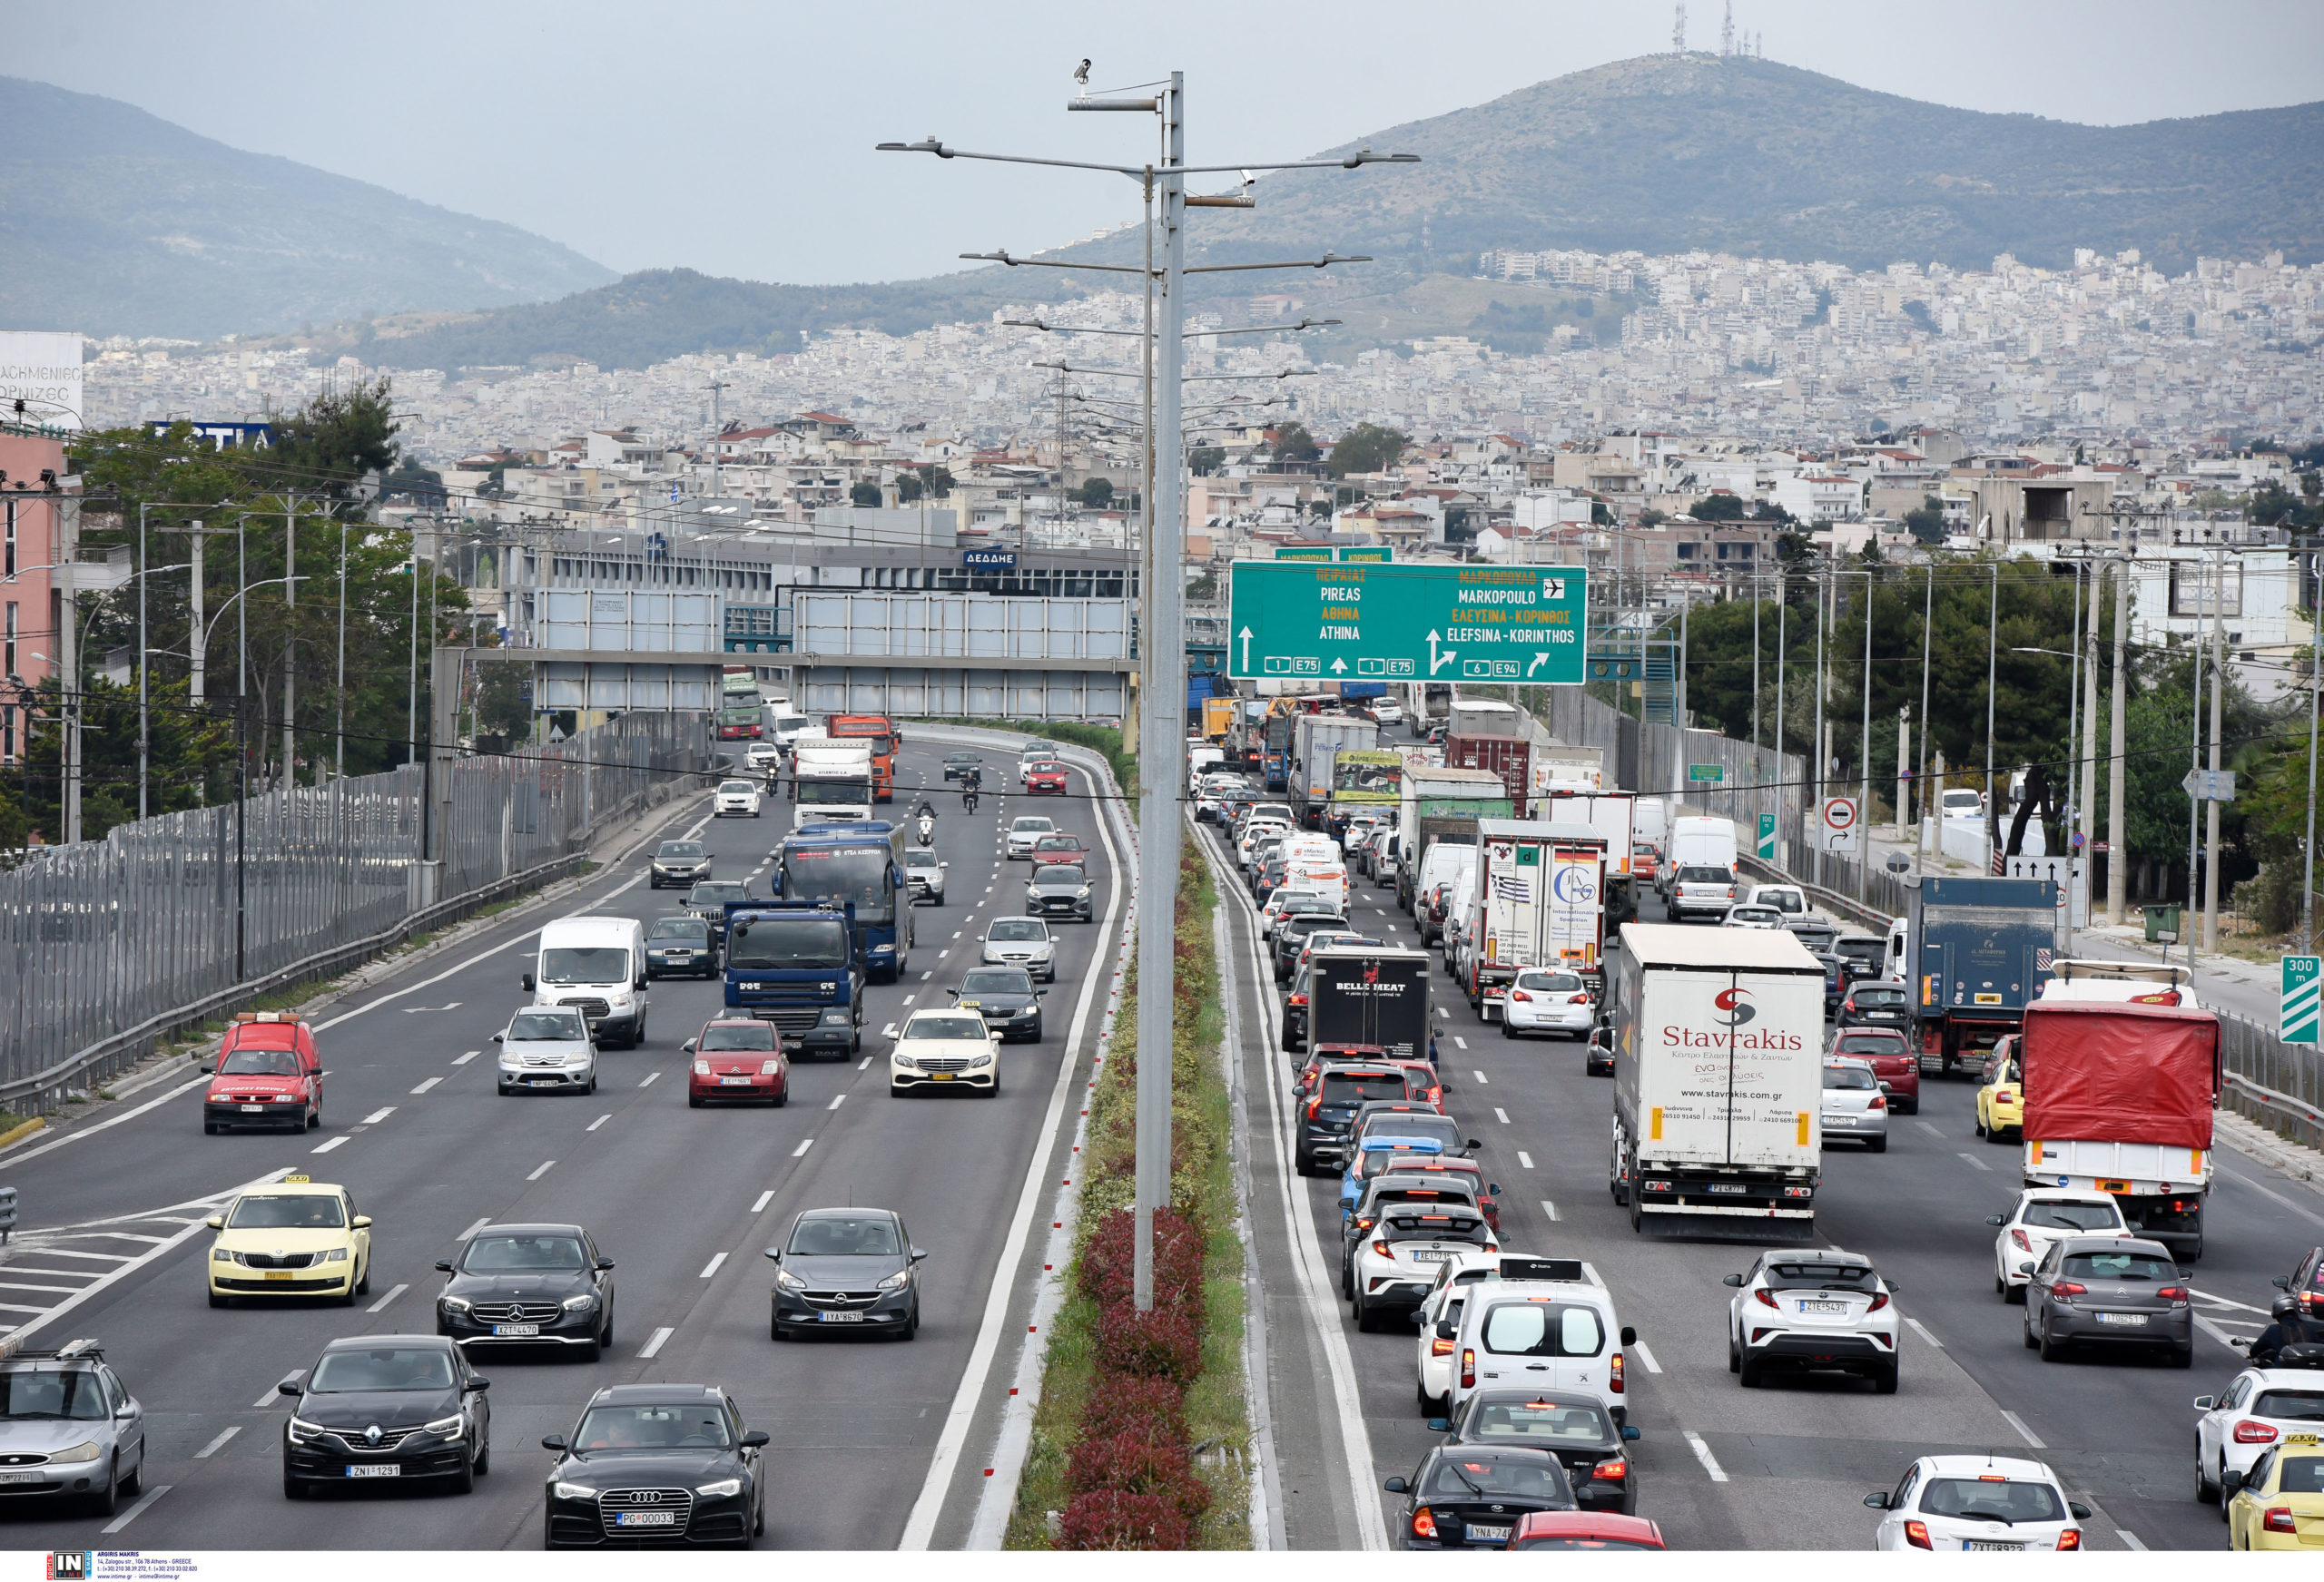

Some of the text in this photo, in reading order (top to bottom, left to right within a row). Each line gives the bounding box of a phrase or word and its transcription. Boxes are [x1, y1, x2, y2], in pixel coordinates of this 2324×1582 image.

[967, 554, 1013, 564] ΔΕΔΔΗΕ
[1316, 568, 1366, 582] ΠΕΙΡΑΙΑΣ
[1459, 570, 1536, 585] ΜΑΡΚΟΠΟΥΛΟ
[1321, 587, 1361, 602] PIREAS
[1458, 589, 1536, 604] MARKOPOULO
[1321, 606, 1360, 620] ΑΘΗΝΑ
[1319, 625, 1360, 640] ATHINA
[1275, 660, 1280, 671] 1
[1370, 661, 1374, 672] 1
[1473, 663, 1481, 673] 6
[1523, 851, 1531, 862] d
[2289, 959, 2313, 972] 300
[1336, 982, 1370, 990] BELLE
[1663, 1026, 1802, 1051] Stavrakis
[1703, 1051, 1748, 1060] Ελαστκών
